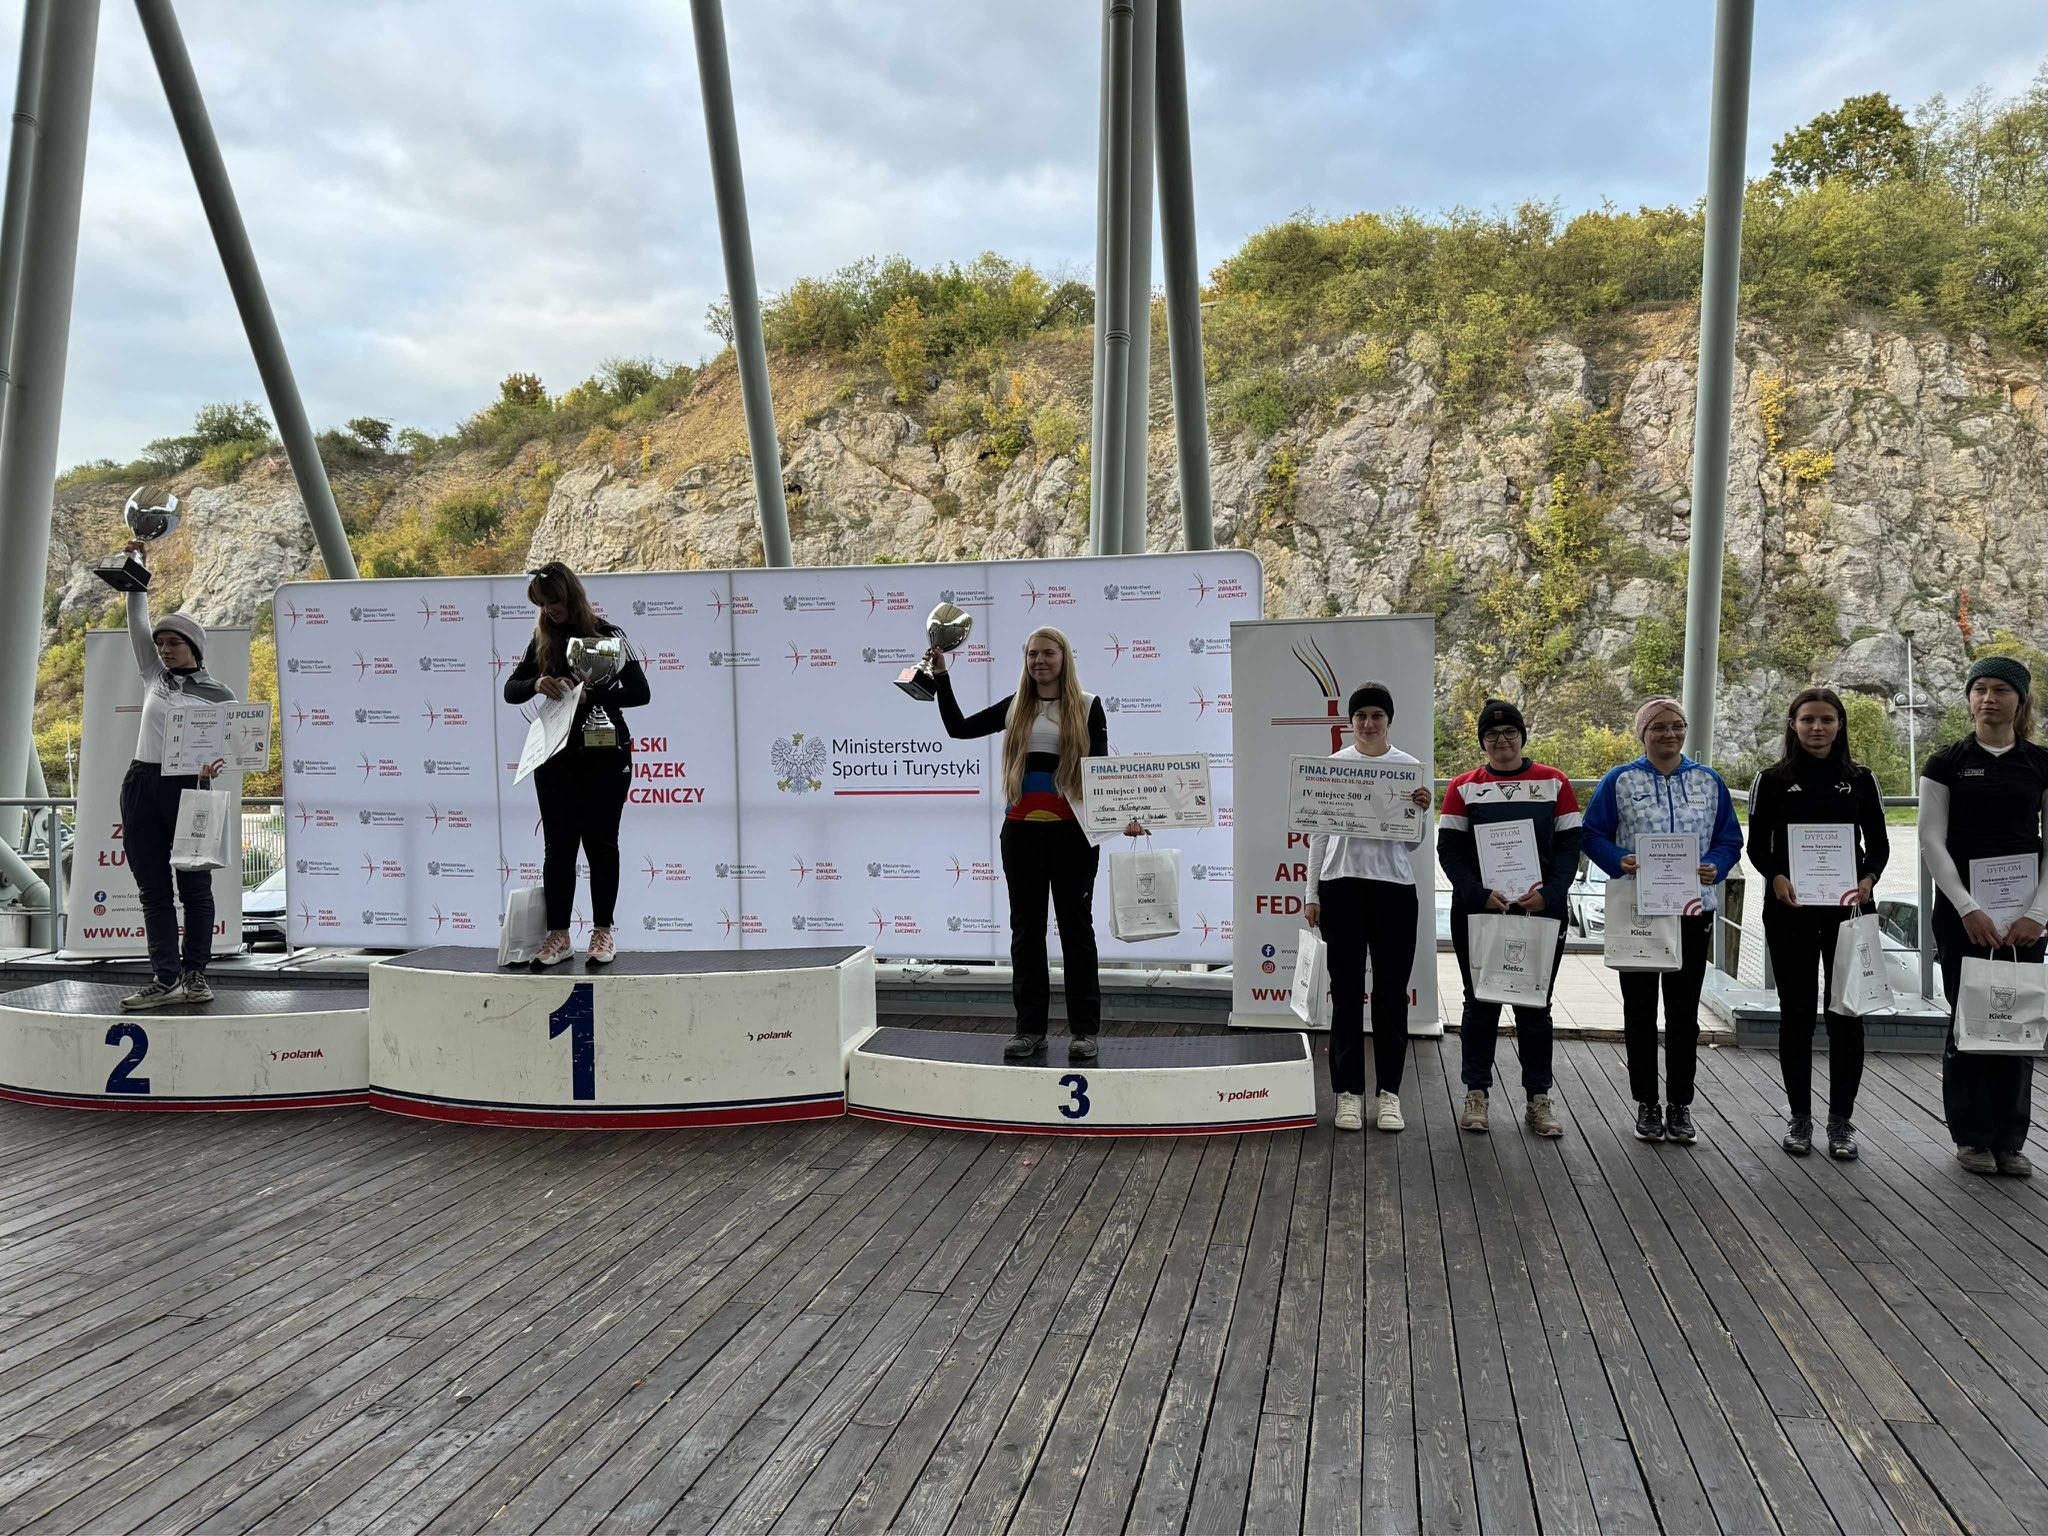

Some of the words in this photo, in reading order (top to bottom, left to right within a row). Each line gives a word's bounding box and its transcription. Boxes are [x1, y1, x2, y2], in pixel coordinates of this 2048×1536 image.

[236, 710, 264, 720] POLSKI
[631, 737, 667, 752] LSKI
[833, 738, 942, 754] Ministerstwo
[634, 763, 686, 782] IĄZEK
[832, 760, 888, 779] Sportu
[893, 760, 897, 775] i
[903, 758, 980, 779] Turystyki
[1091, 764, 1118, 774] FINAŁ
[1120, 762, 1165, 773] PUCHARU
[1167, 761, 1200, 771] POLSKI
[1299, 765, 1328, 775] FINAŁ
[1329, 766, 1378, 779] PUCHARU
[1380, 770, 1416, 781] POLSKI
[629, 788, 705, 803] CZNICZY
[1093, 788, 1103, 796] III
[1106, 787, 1135, 796] miejsce
[1143, 786, 1157, 794] 000
[1159, 785, 1166, 793] zł
[1302, 789, 1313, 797] IV
[1315, 790, 1345, 800] miejsce
[1364, 793, 1371, 801] zł
[1490, 830, 1520, 839] DYPLOM
[1986, 865, 2021, 874] DYPLOM
[1630, 929, 1652, 937] Kielce
[1503, 964, 1524, 972] Kielce
[549, 983, 595, 1101] 1
[756, 1029, 793, 1042] polanik
[105, 1022, 150, 1094] 2
[281, 1048, 324, 1061] polanik
[1058, 1074, 1090, 1119] 3
[1228, 1088, 1269, 1102] polanik
